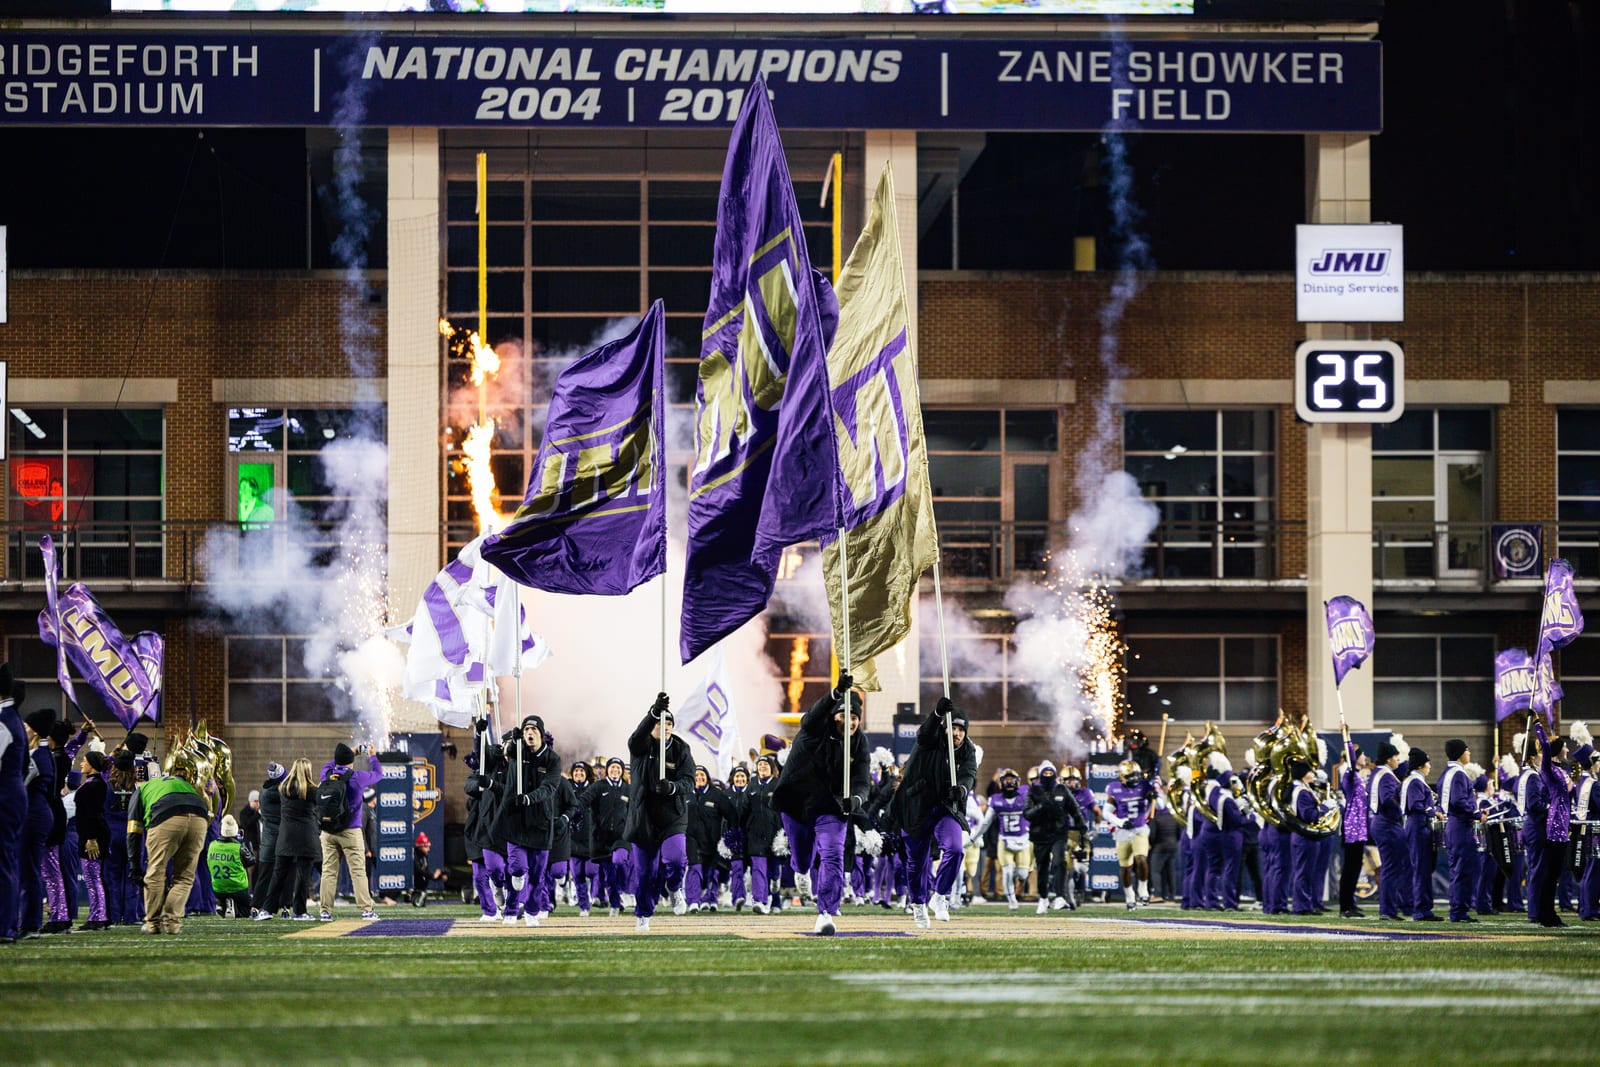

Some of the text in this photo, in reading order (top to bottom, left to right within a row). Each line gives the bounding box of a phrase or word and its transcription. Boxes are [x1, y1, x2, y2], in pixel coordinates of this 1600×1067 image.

[0, 44, 258, 77] IDGEFORTH
[361, 46, 903, 83] NATIONAL CHAMPIONS
[998, 51, 1344, 83] ZANE SHOWKER
[4, 82, 204, 114] STADIUM
[475, 87, 775, 121] 2004 201
[1112, 89, 1231, 120] FIELD
[1312, 252, 1387, 272] JMU
[1303, 283, 1399, 296] Dining Services
[1313, 354, 1386, 409] 25
[66, 611, 140, 701] JMU
[1003, 815, 1021, 832] 12
[1127, 801, 1139, 819] 5
[210, 852, 236, 862] MEDIA
[213, 865, 230, 879] 23
